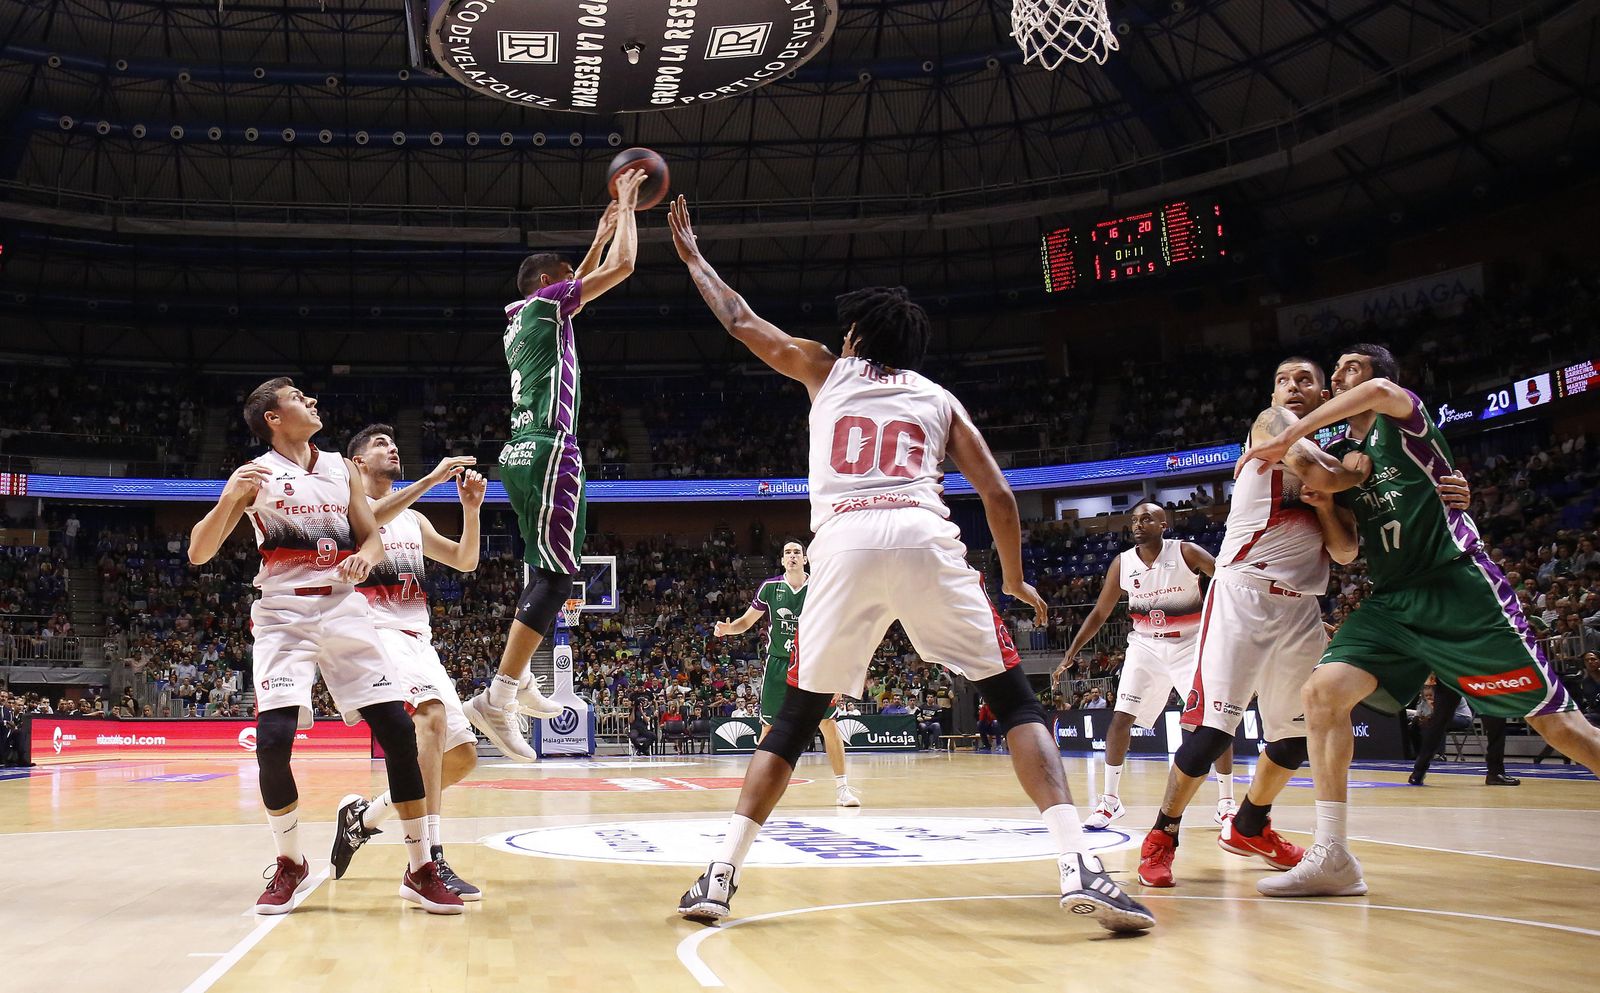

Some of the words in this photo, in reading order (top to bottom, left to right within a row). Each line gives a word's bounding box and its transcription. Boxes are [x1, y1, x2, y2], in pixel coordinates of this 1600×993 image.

[457, 0, 495, 22] CO
[664, 0, 698, 40] RESE
[790, 0, 816, 38] VELA
[449, 24, 472, 44] DE
[576, 32, 605, 51] LA
[660, 44, 689, 62] LA
[777, 41, 807, 59] DE
[450, 46, 557, 107] VELAZQUEZ
[571, 55, 603, 107] RESERVA
[650, 66, 684, 105] GRUPO
[680, 61, 786, 104] PORTICO
[1108, 228, 1119, 238] 16
[1138, 221, 1152, 233] 20
[1487, 390, 1510, 412] 20
[829, 415, 927, 480] 00
[1380, 519, 1401, 553] 17
[315, 537, 338, 568] 9
[1149, 610, 1166, 629] 8
[1467, 676, 1532, 691] worten
[867, 730, 916, 746] Unicaja
